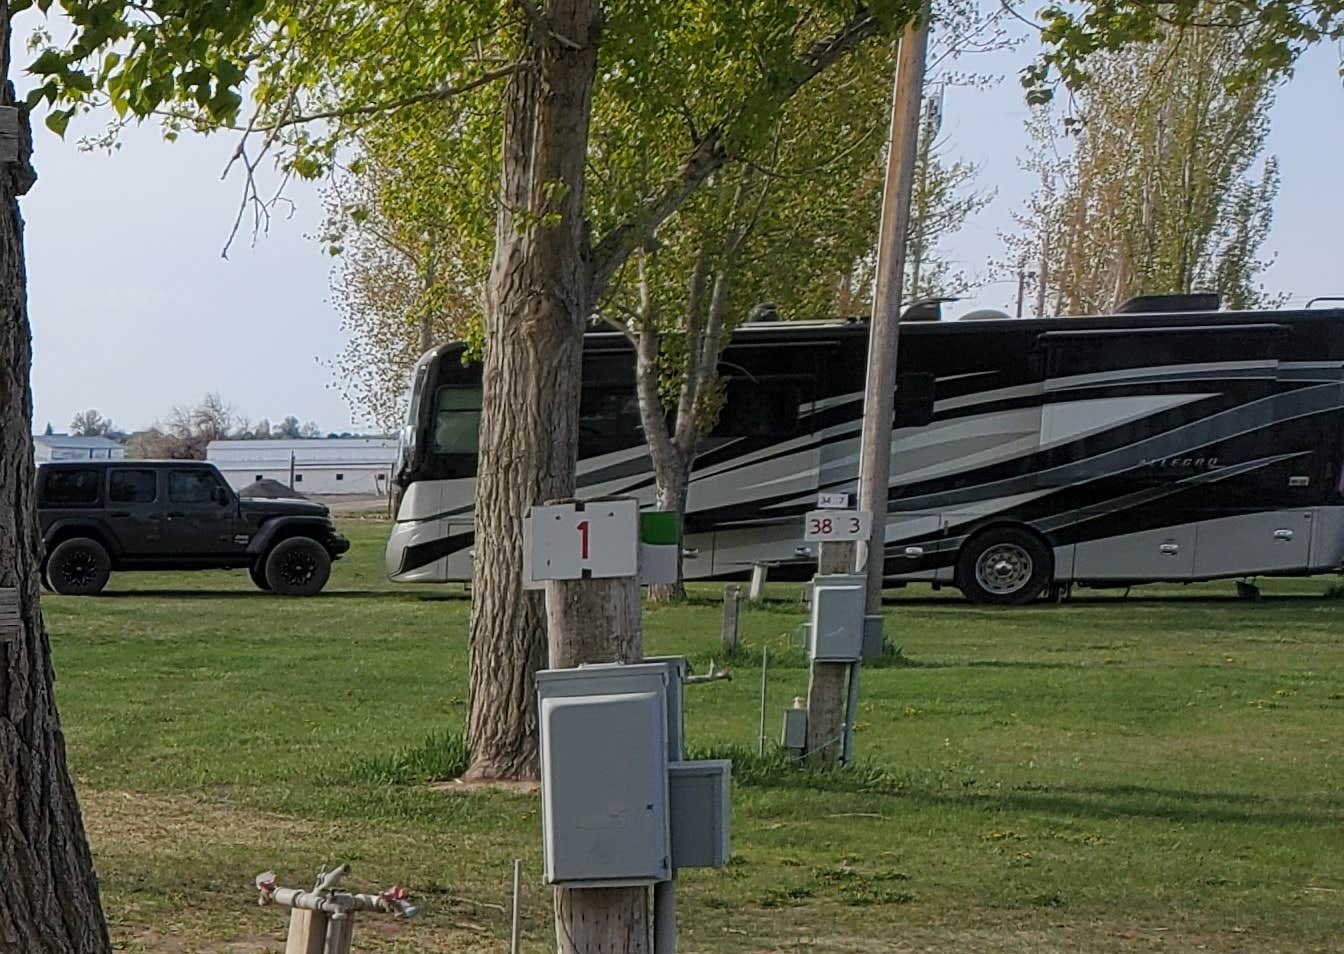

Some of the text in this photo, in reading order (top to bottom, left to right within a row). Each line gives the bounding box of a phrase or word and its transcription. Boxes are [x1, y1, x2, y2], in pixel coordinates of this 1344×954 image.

[810, 517, 861, 534] 38 3
[577, 521, 589, 559] 1
